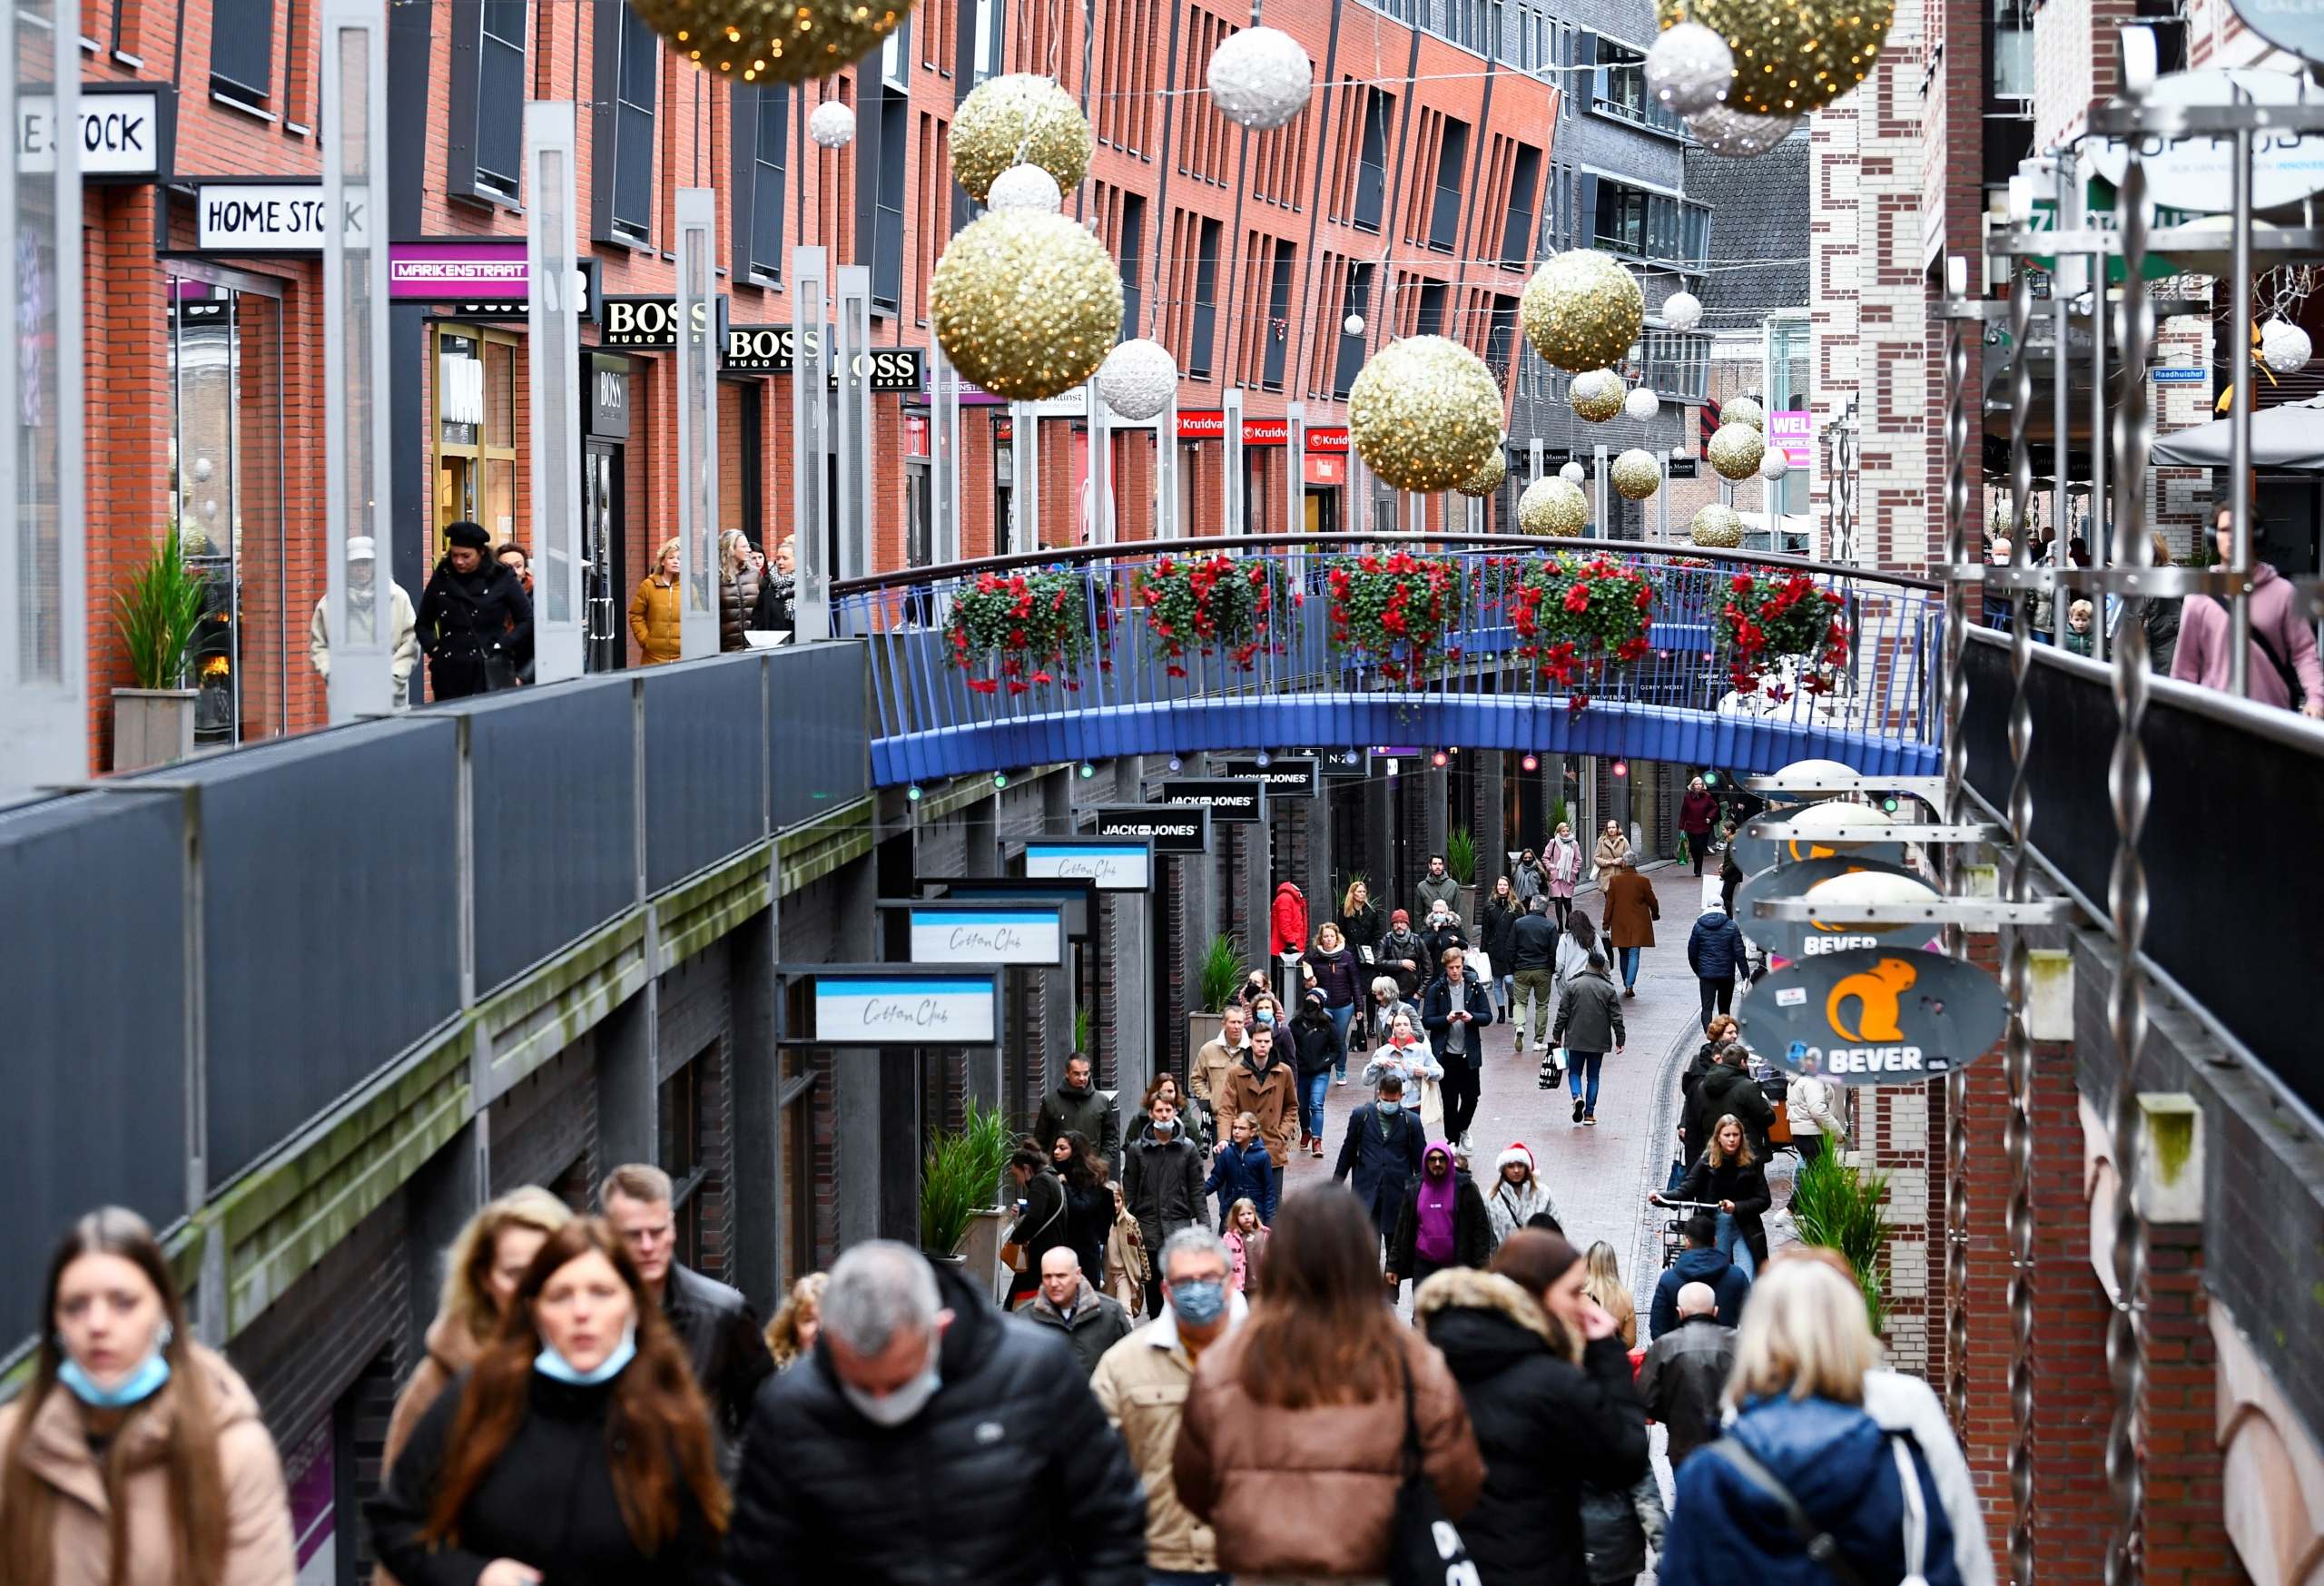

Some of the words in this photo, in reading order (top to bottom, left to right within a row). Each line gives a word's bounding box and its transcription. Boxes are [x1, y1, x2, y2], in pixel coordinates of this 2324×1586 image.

[209, 201, 281, 232] HOME
[287, 201, 363, 232] STOK
[398, 264, 525, 277] MARIKENSTRAAT
[609, 335, 655, 343] HUGO
[729, 360, 770, 368] HUGO
[876, 379, 919, 387] BOSS
[600, 370, 622, 409] BOSS
[1255, 428, 1295, 438] Kruidv
[1323, 435, 1350, 445] Kruid
[1270, 773, 1307, 783] JONES
[1167, 796, 1200, 805] JACK
[1211, 796, 1251, 806] JONES
[1102, 824, 1137, 835] JACK
[1150, 824, 1196, 835] JONES
[1058, 858, 1093, 879] Cotton
[1094, 859, 1117, 879] Club
[950, 927, 992, 951] Cotton
[994, 928, 1021, 951] Club
[863, 998, 914, 1026] Cotton
[916, 999, 948, 1028] Club
[1828, 1046, 1923, 1074] BEVER
